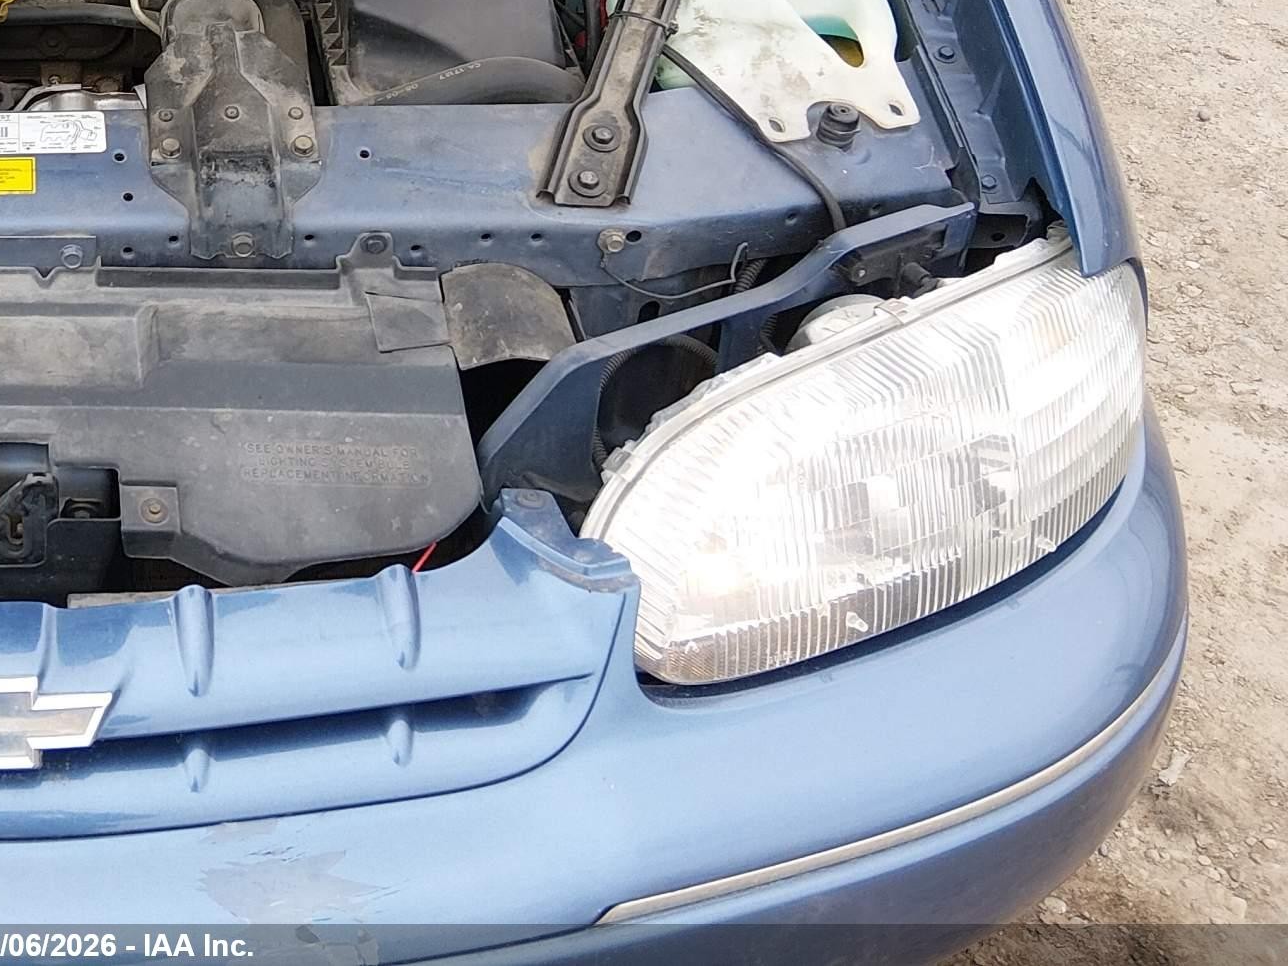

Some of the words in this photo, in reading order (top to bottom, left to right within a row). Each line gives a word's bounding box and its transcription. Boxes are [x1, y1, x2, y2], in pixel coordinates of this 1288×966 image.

[247, 442, 272, 454] SEE
[336, 445, 388, 457] MANUAL
[392, 447, 418, 458] FOR
[243, 467, 336, 481] REPLACEMENT
